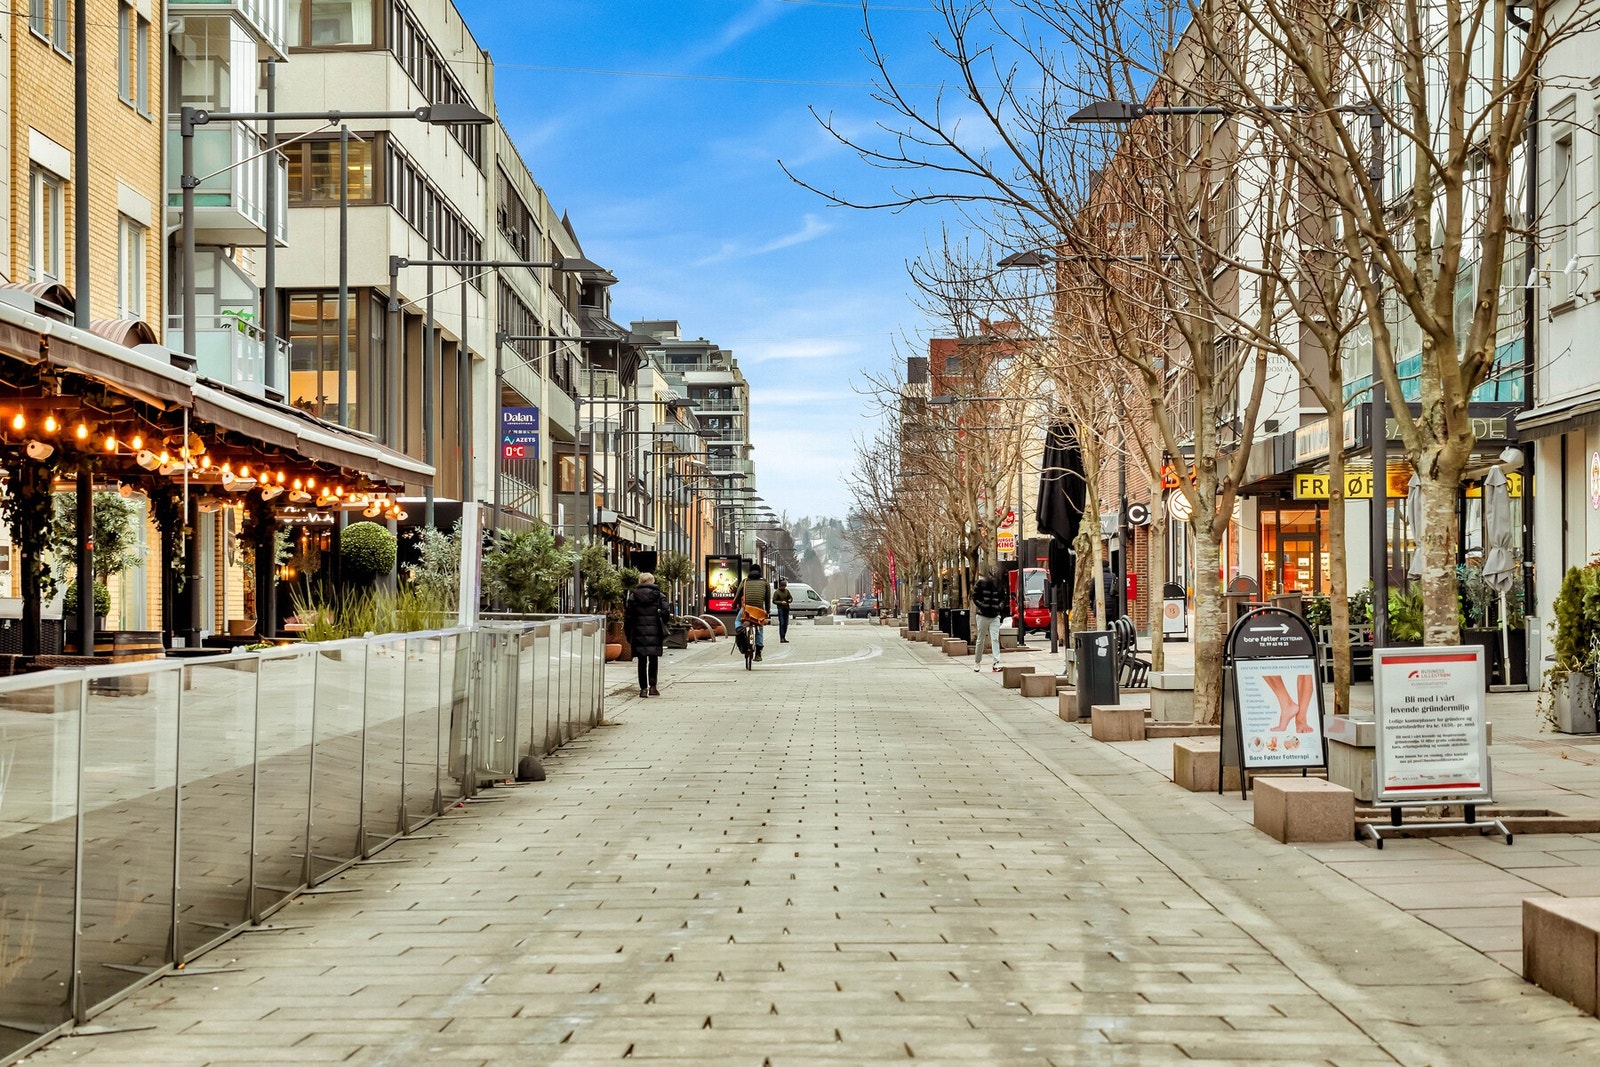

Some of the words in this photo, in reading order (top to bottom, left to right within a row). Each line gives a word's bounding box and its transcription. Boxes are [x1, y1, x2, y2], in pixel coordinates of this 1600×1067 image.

[503, 412, 536, 422] Dalan.
[1404, 695, 1416, 703] Bli
[1417, 695, 1434, 703] med
[1440, 694, 1455, 702] vårt
[1390, 705, 1420, 713] levende
